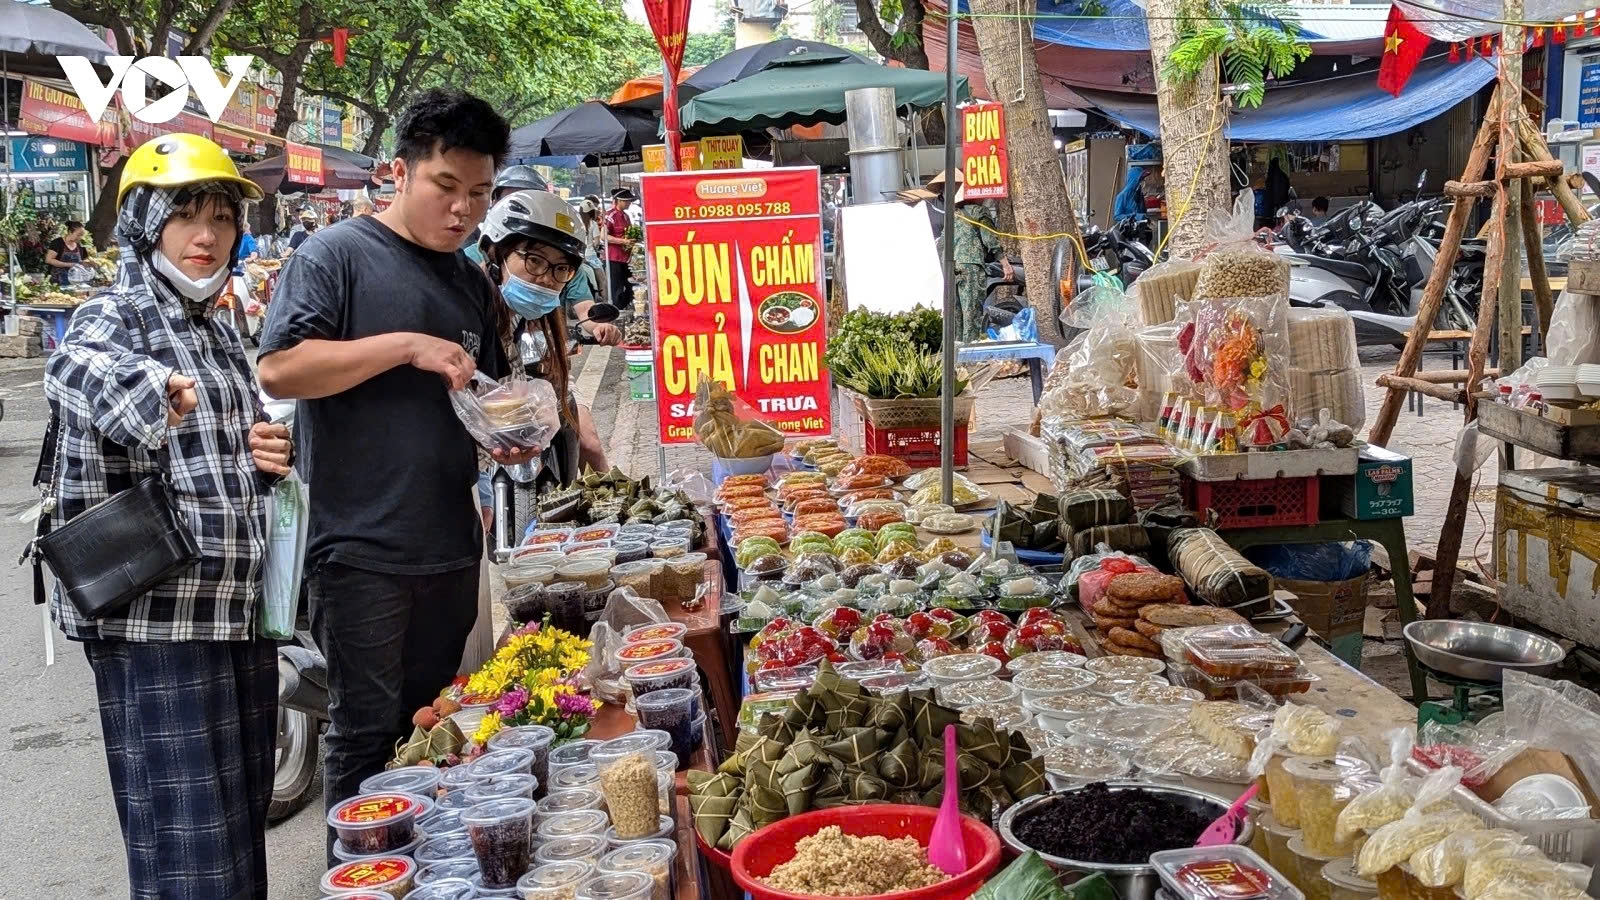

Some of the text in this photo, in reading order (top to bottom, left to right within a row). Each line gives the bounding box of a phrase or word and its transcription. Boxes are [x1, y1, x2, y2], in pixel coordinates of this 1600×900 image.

[965, 105, 1000, 142] BÚN
[52, 157, 76, 167] NGAY
[722, 139, 739, 152] QUAY
[966, 145, 1002, 187] CHẢ
[674, 202, 790, 219] ĐT: 0988 095 788
[655, 231, 732, 306] BÚN
[751, 229, 816, 287] CHẤM
[662, 311, 736, 396] CHẢ
[759, 342, 819, 385] CHAN
[758, 395, 818, 413] TRƯA
[802, 417, 824, 429] Viet
